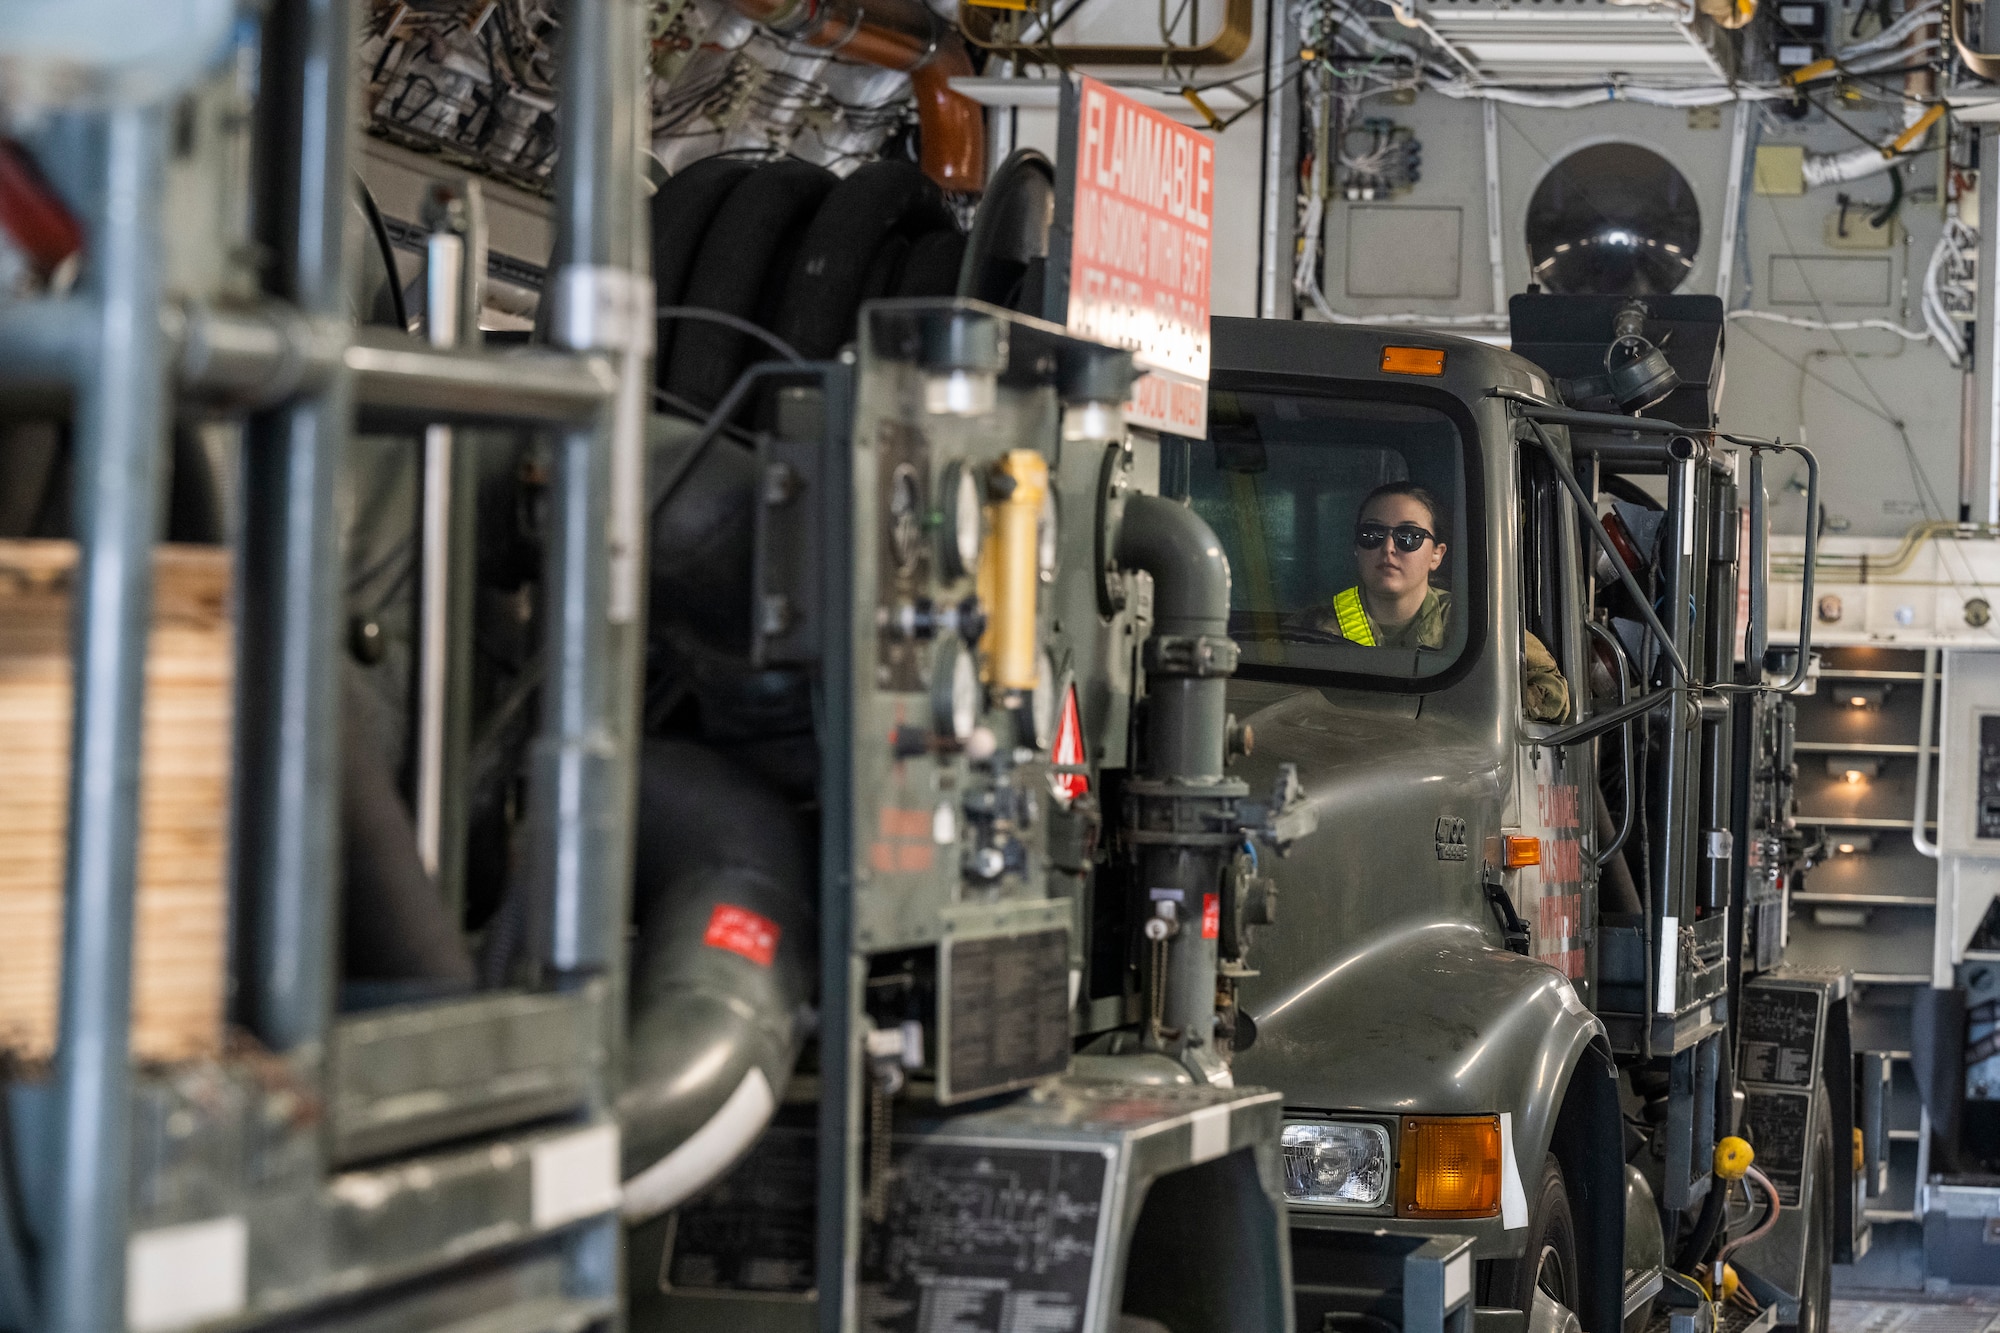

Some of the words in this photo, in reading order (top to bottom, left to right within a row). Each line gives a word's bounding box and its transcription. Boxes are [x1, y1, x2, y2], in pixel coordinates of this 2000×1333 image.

[1082, 89, 1211, 231] FLAMMABLE
[1078, 187, 1098, 258] NO
[1099, 195, 1147, 278] SMOKING
[1147, 215, 1182, 290] WITHIN
[1537, 784, 1579, 827] FLAMMABLE
[1540, 840, 1550, 884] NO
[1552, 840, 1581, 882] SMOKING
